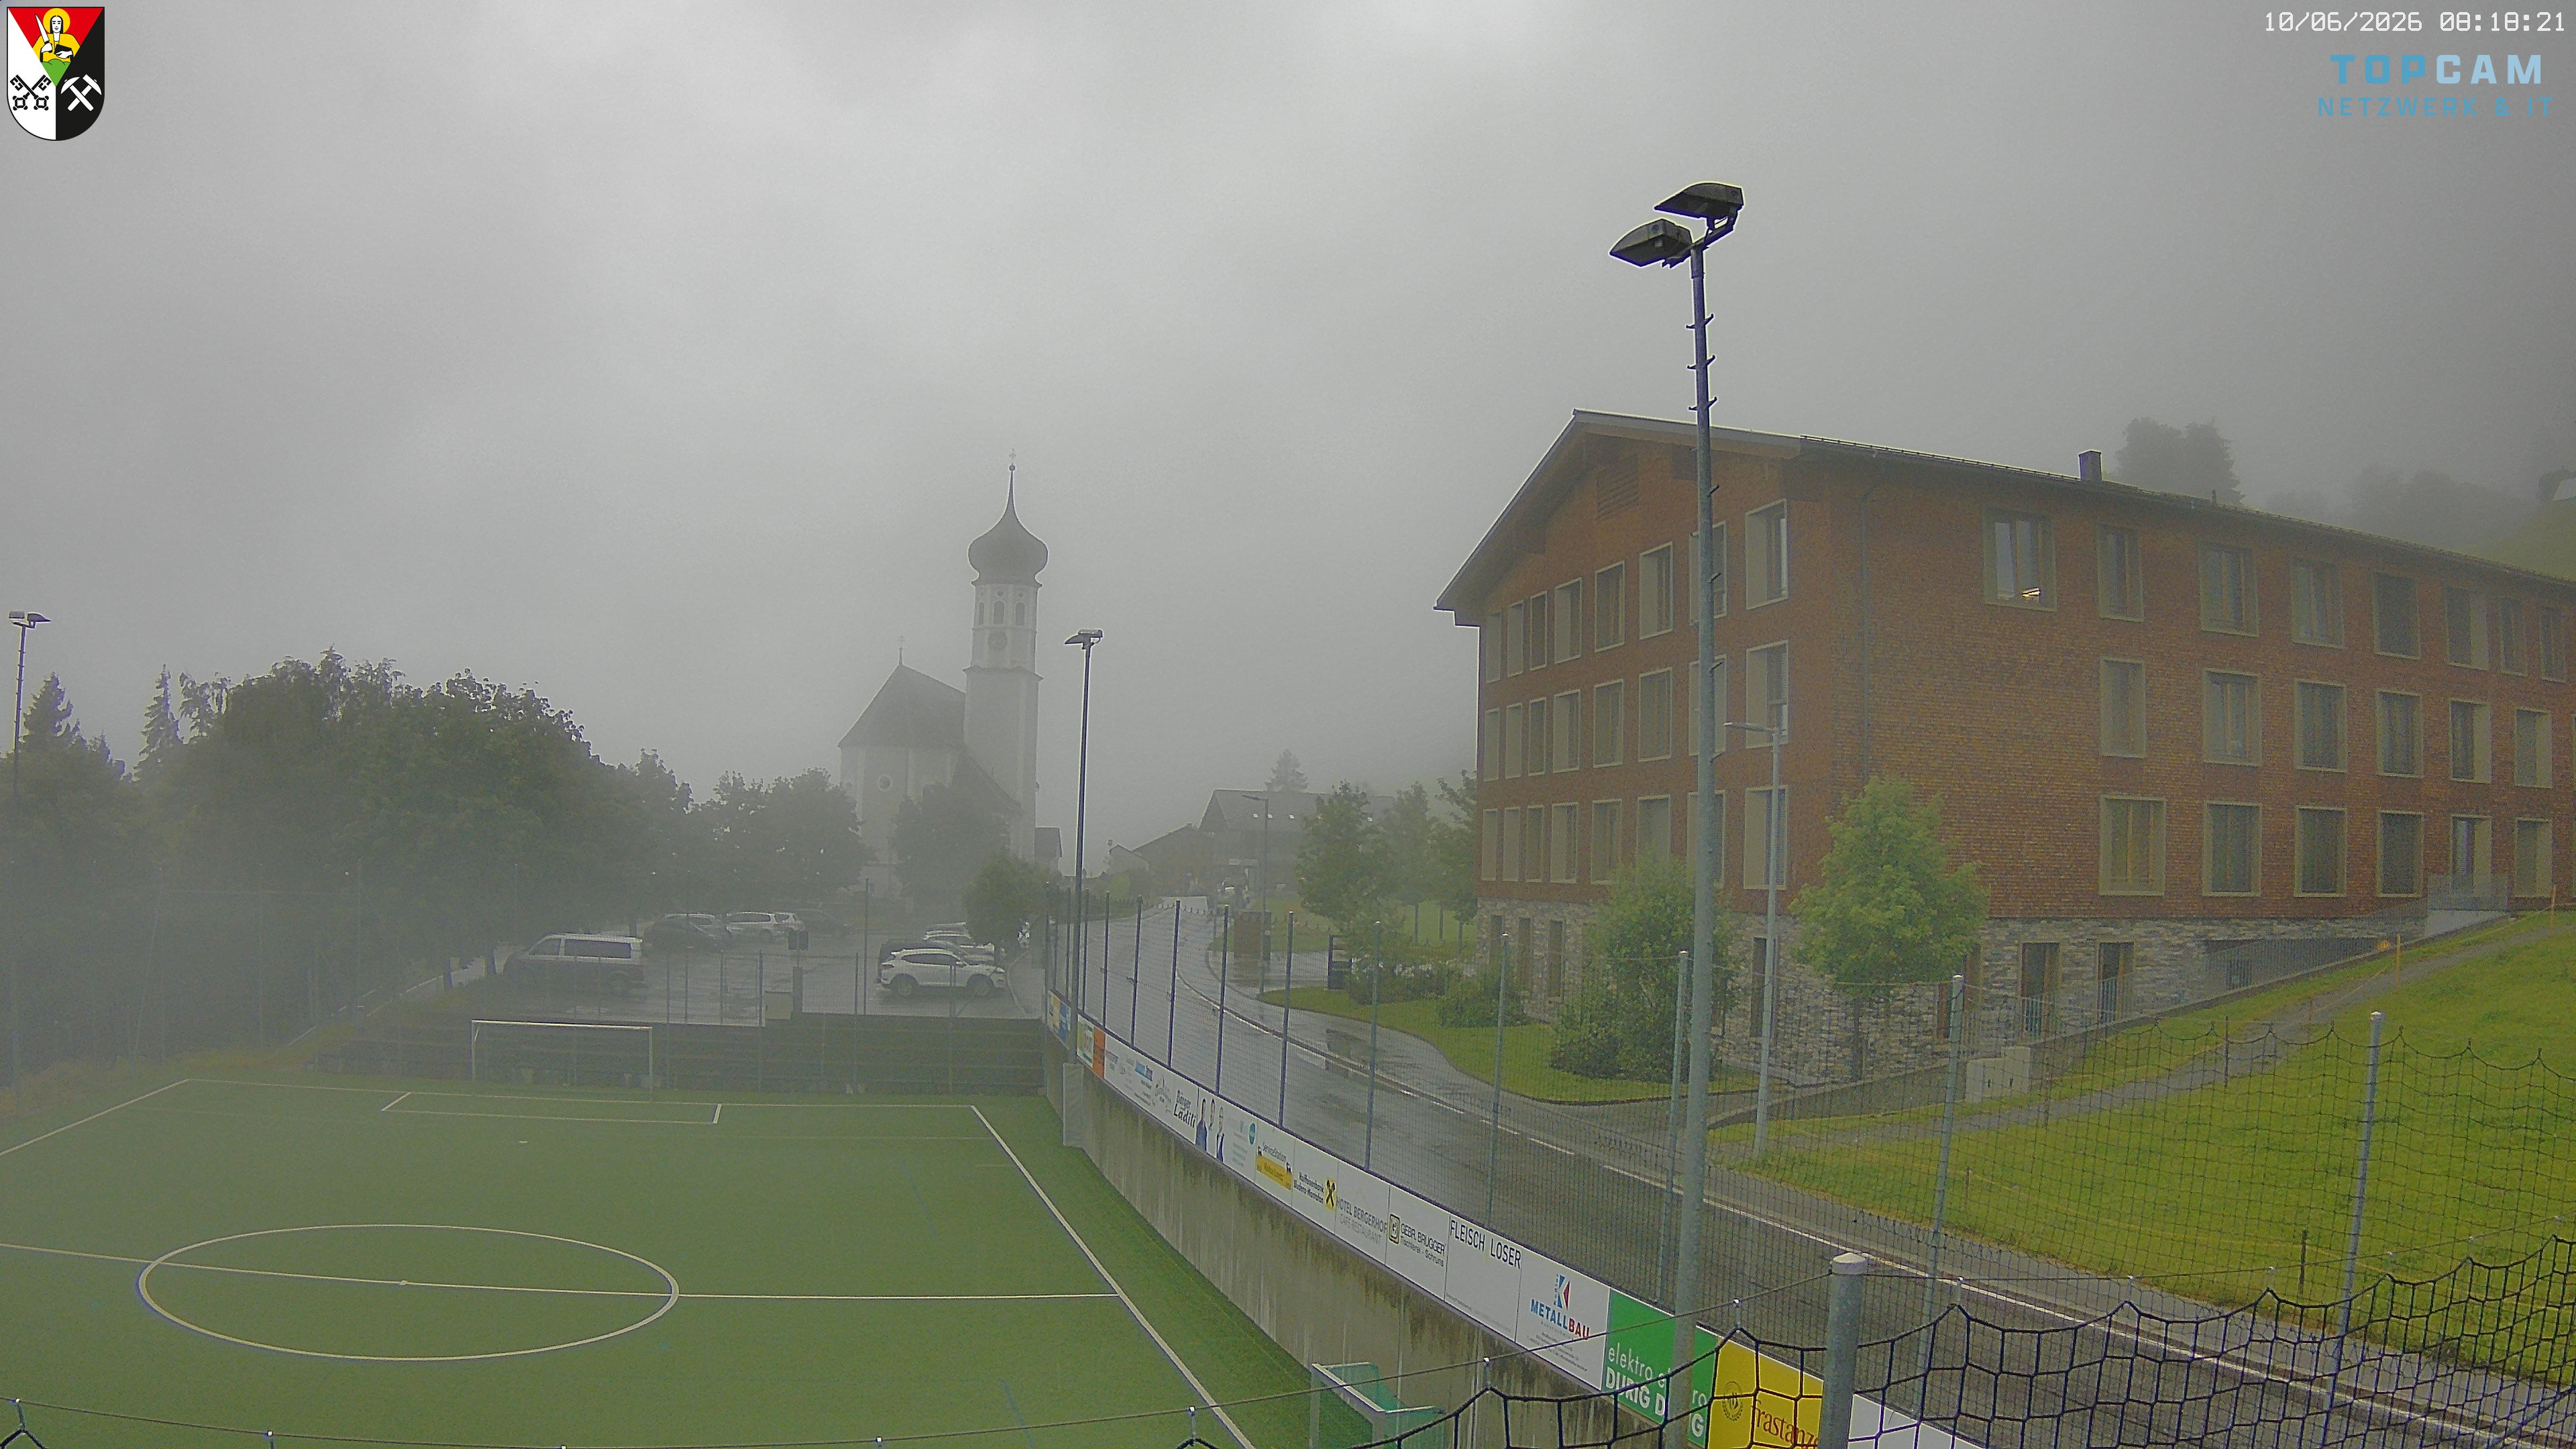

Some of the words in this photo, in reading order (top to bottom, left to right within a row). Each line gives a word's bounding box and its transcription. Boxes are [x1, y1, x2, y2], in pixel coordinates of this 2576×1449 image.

[1336, 1197, 1352, 1216] HOTEL
[1354, 1206, 1388, 1234] BERGERHOF
[1417, 1232, 1446, 1256] BRUGGER
[1425, 1249, 1444, 1267] Schruns
[1450, 1220, 1486, 1252] FLEISCH
[1490, 1238, 1521, 1269] LOSER
[1530, 1299, 1590, 1340] METALLBAU
[1608, 1342, 1653, 1381] elektro
